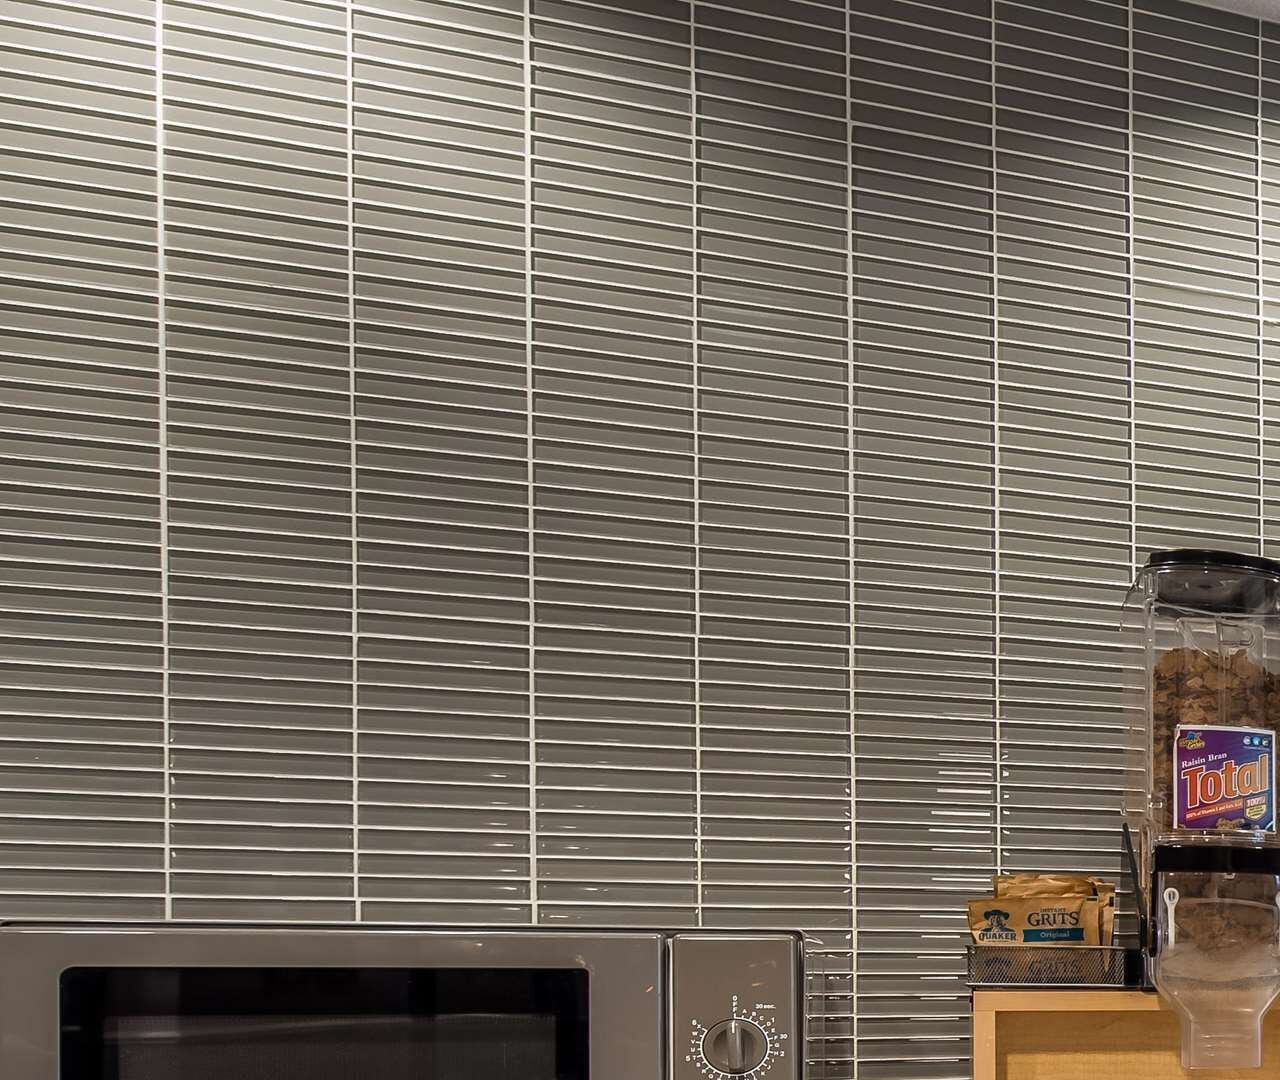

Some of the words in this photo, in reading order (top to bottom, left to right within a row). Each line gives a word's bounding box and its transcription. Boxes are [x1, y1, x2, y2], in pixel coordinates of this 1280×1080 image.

[1181, 757, 1206, 769] Raisin
[1207, 752, 1228, 762] Bran
[1181, 753, 1269, 809] Total
[1027, 911, 1079, 926] GRITS
[978, 932, 1016, 941] QUAKER
[1040, 931, 1070, 939] Original
